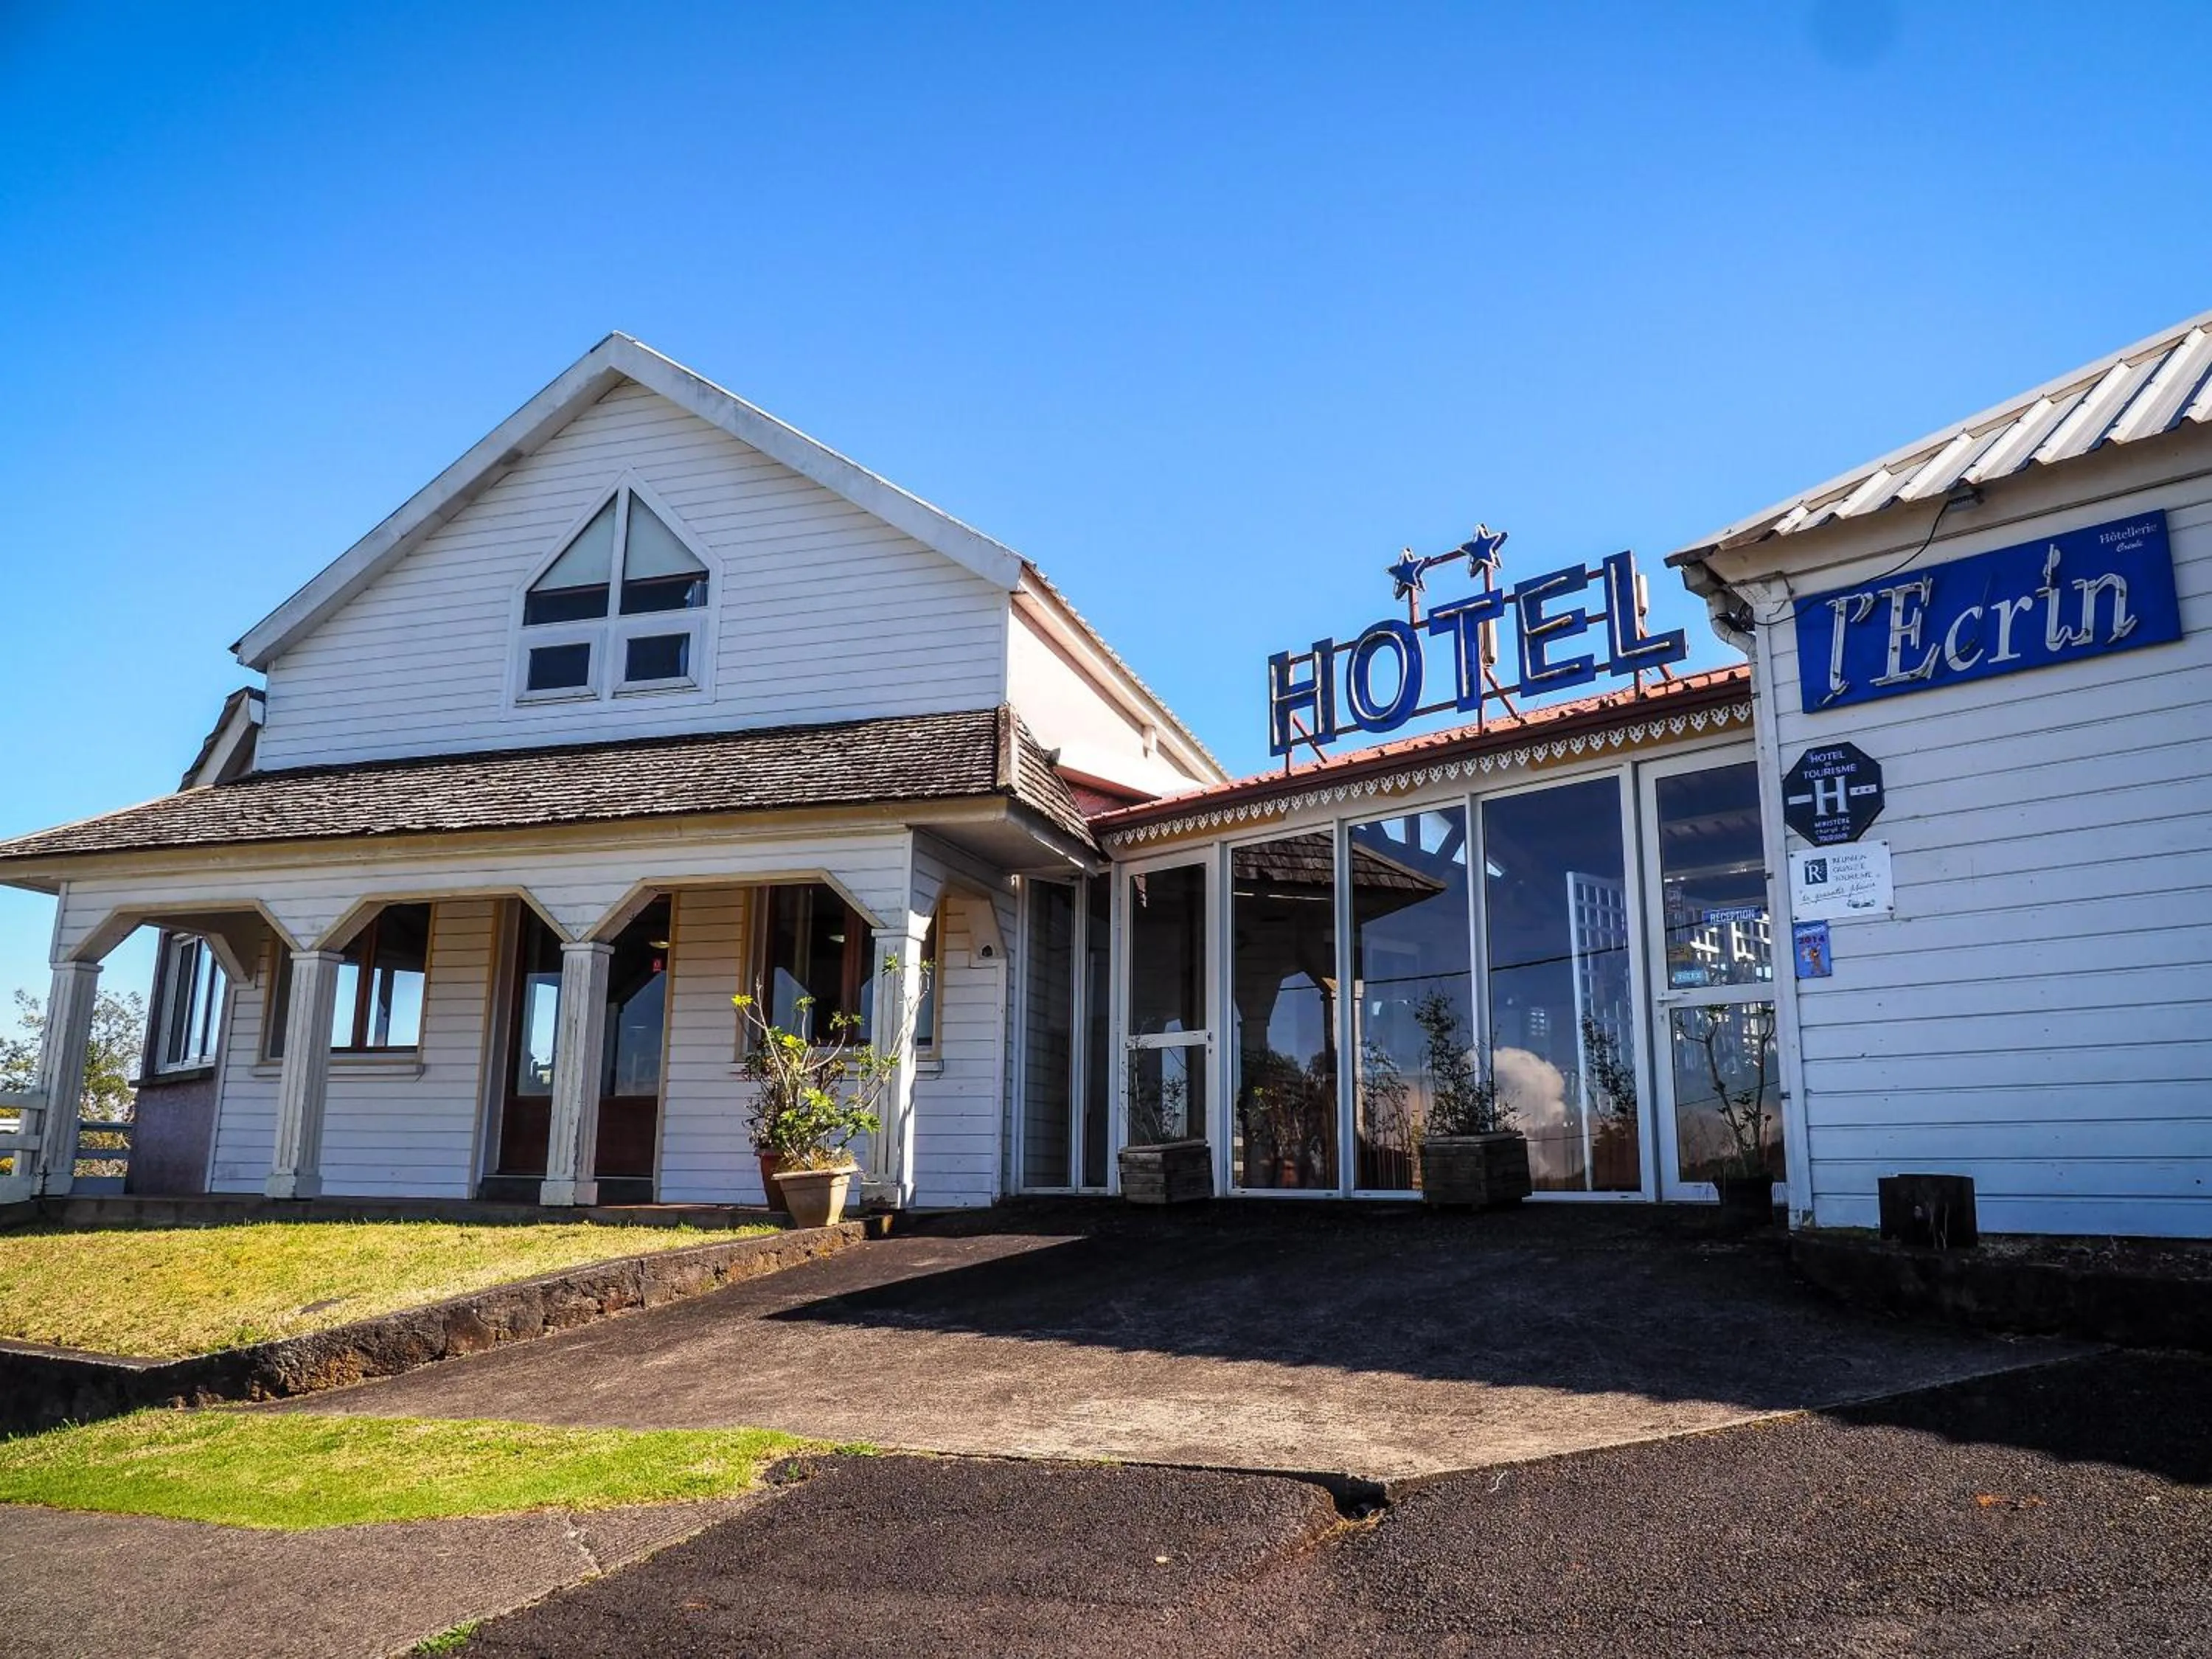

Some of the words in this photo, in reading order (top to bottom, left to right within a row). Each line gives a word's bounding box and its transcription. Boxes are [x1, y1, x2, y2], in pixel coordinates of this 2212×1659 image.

[1268, 550, 1688, 757] HOTEL
[1809, 750, 1846, 763] HOTEL
[1803, 763, 1857, 779] TOURISME
[1814, 775, 1851, 816] H
